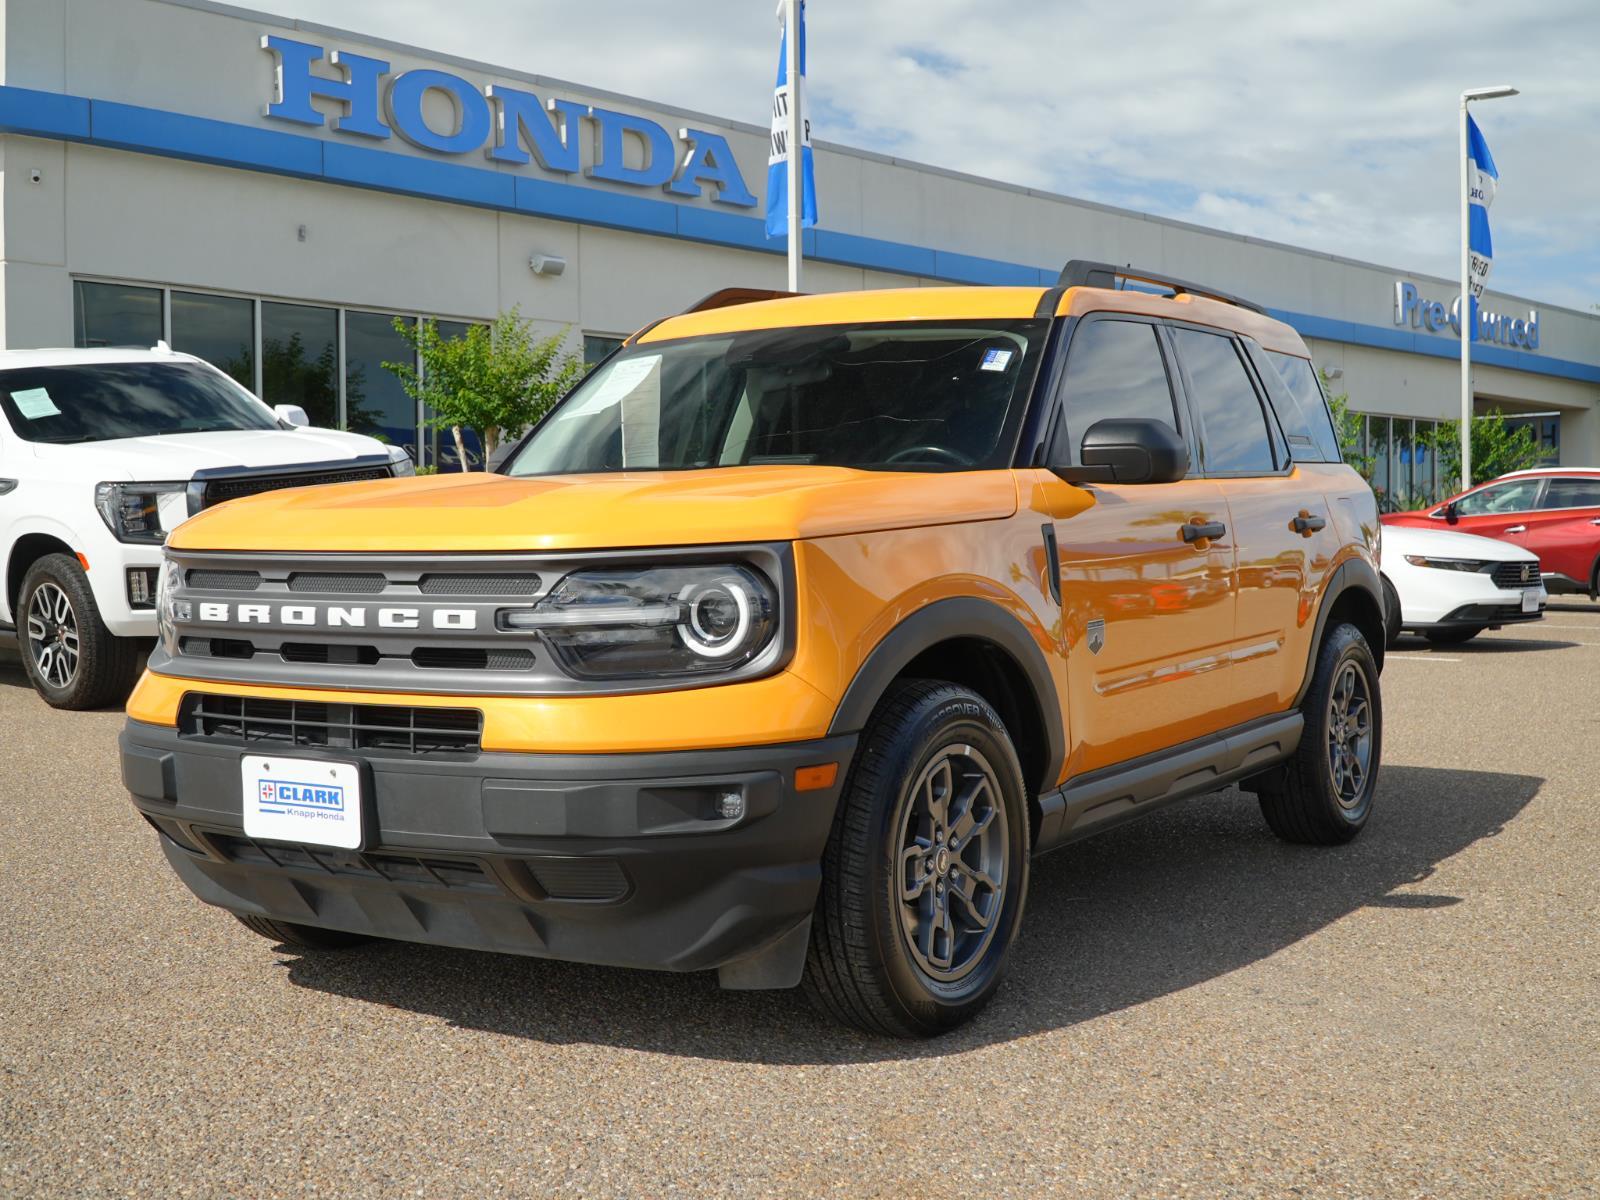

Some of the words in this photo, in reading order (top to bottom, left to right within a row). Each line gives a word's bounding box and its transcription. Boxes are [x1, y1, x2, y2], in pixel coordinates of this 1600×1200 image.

[260, 35, 758, 208] HONDA
[199, 602, 477, 630] BRONCO
[278, 786, 340, 805] CLARK
[286, 808, 316, 819] Knapp
[316, 811, 345, 822] Honda
